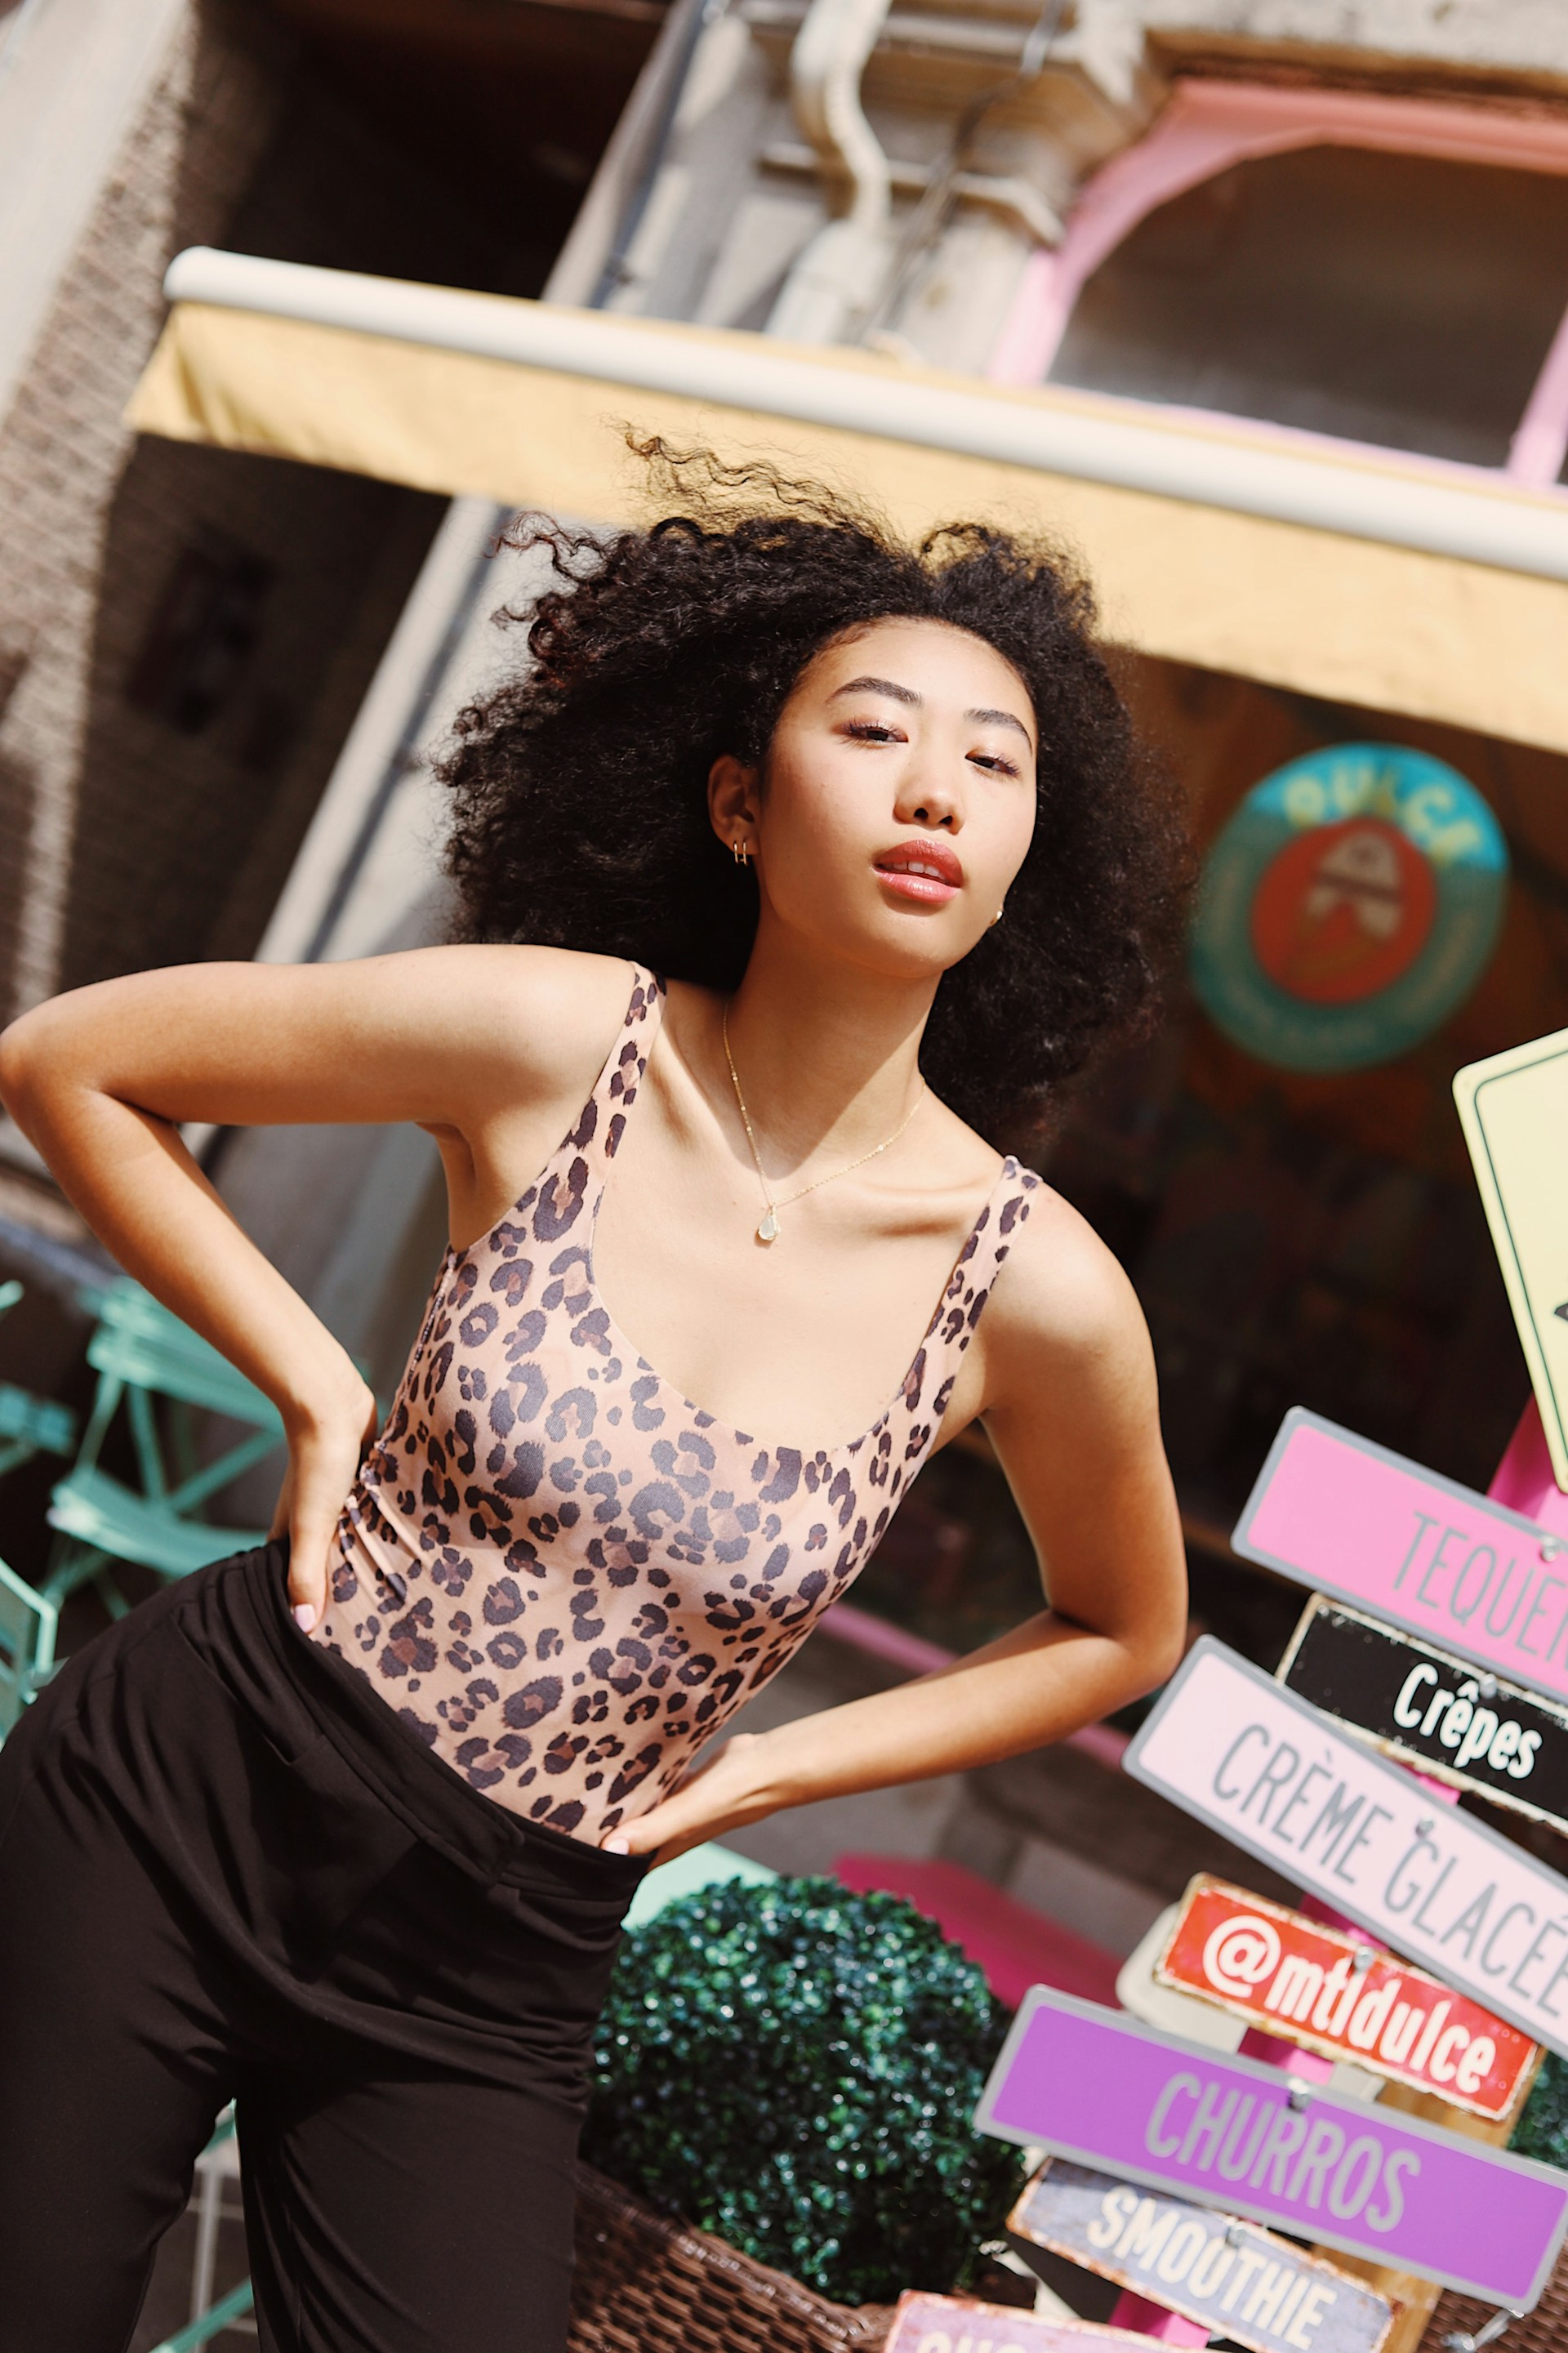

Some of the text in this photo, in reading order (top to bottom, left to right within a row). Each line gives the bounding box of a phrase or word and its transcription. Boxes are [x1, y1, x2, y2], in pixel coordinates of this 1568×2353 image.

[1393, 1662, 1543, 1779] Crêpes
[1212, 1723, 1394, 1885] CRÈME
[1201, 1914, 1497, 2094] @mtldulce
[1143, 2071, 1422, 2234] CHURROS
[1086, 2184, 1339, 2351] SMOOTHIE
